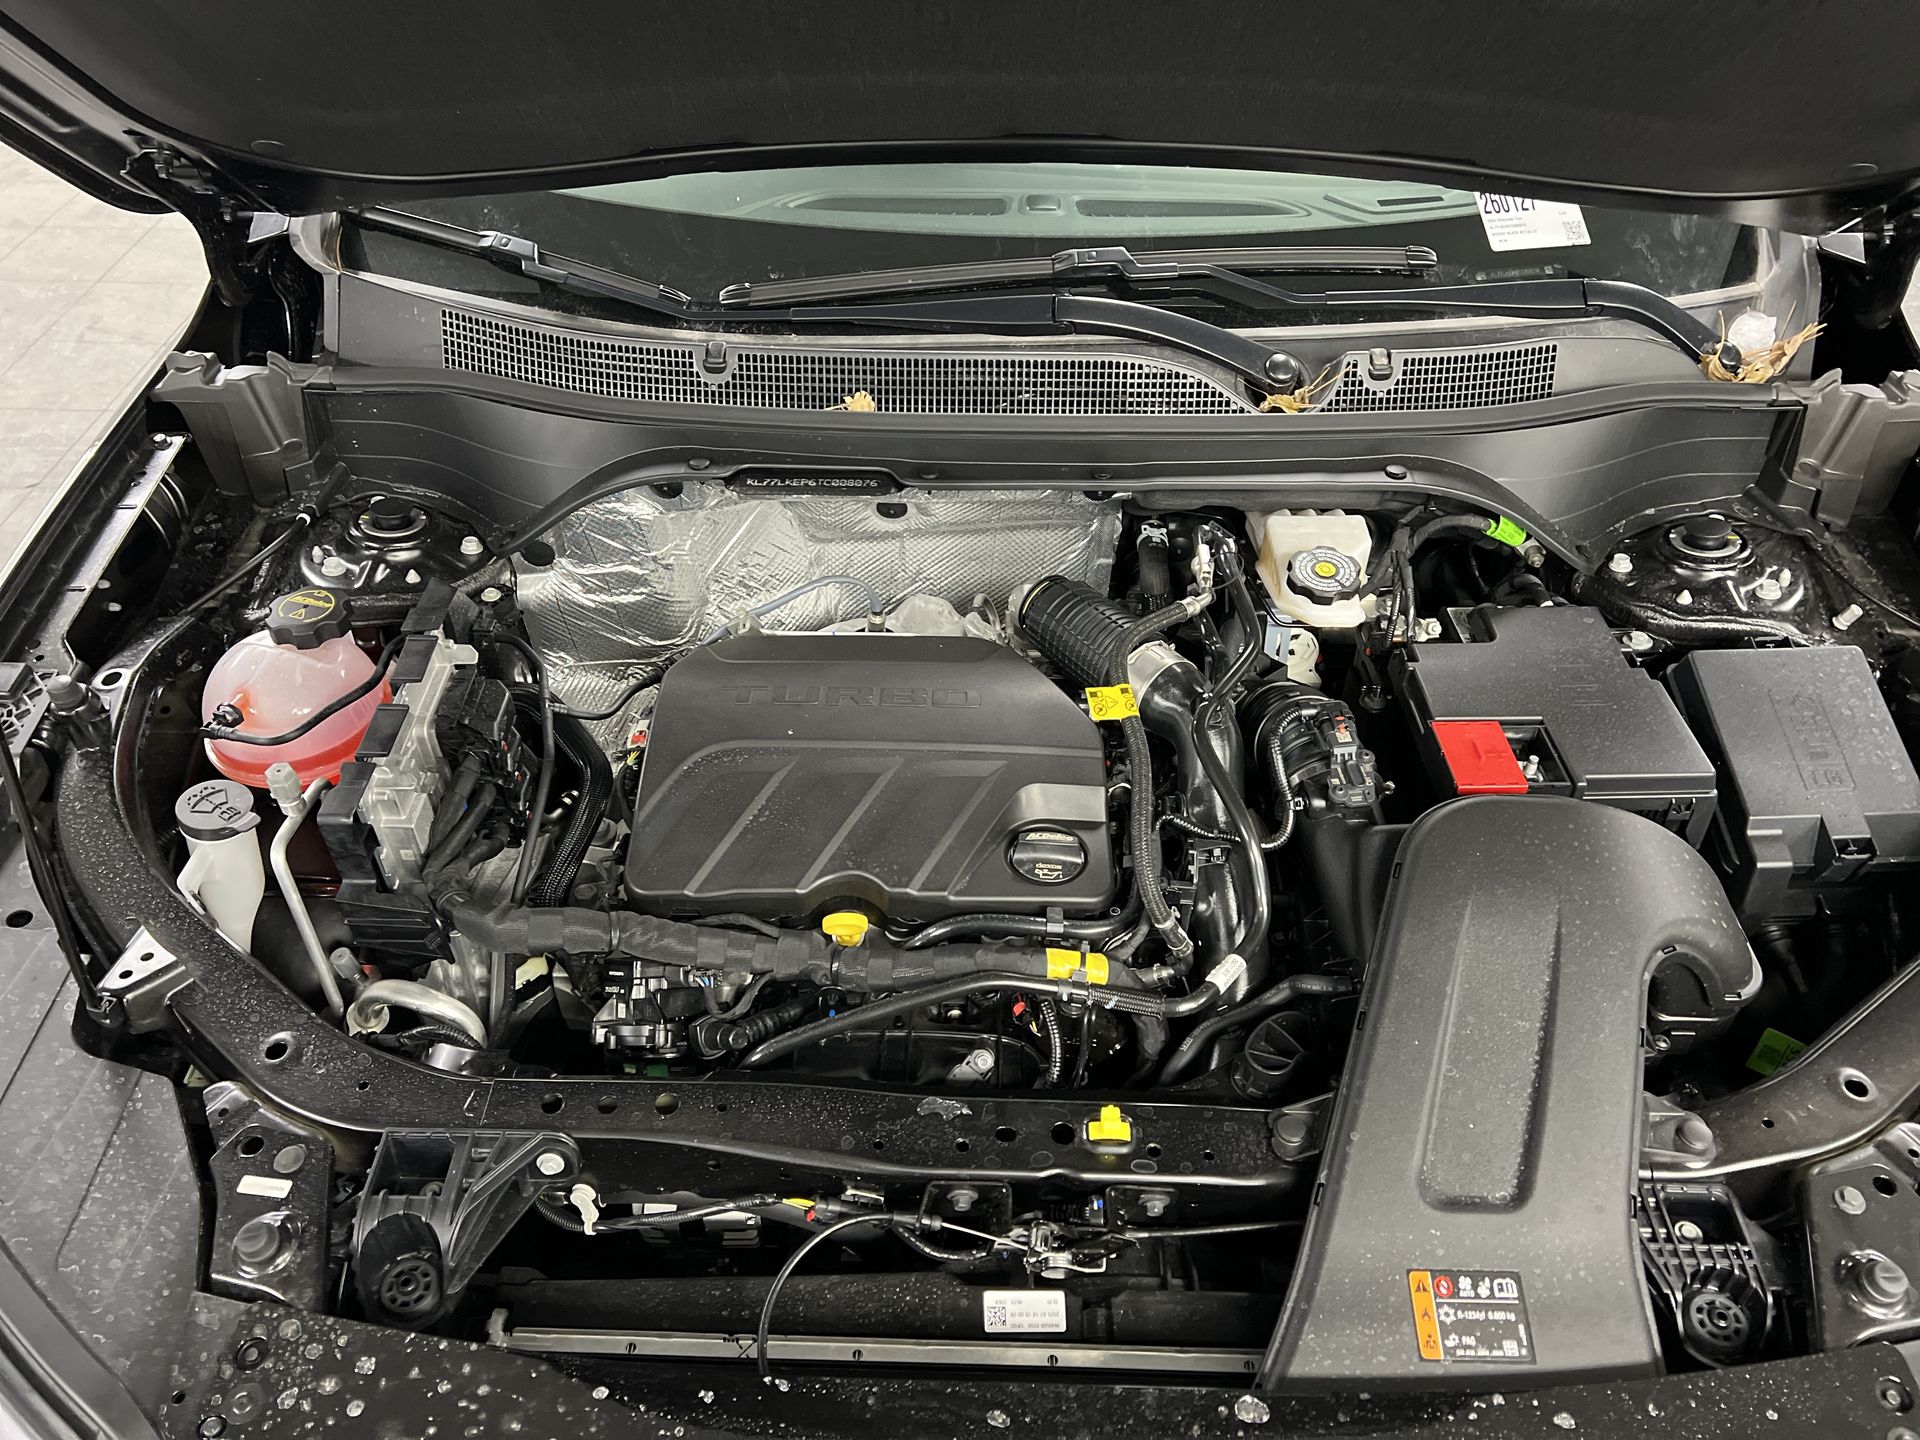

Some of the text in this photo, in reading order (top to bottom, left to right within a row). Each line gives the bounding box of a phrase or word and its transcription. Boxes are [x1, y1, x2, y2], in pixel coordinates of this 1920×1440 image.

[746, 478, 879, 487] KL77LKEP6TC008076
[721, 685, 983, 708] TURBO
[1026, 832, 1074, 842] ACDelco
[1459, 1290, 1475, 1298] AUTO
